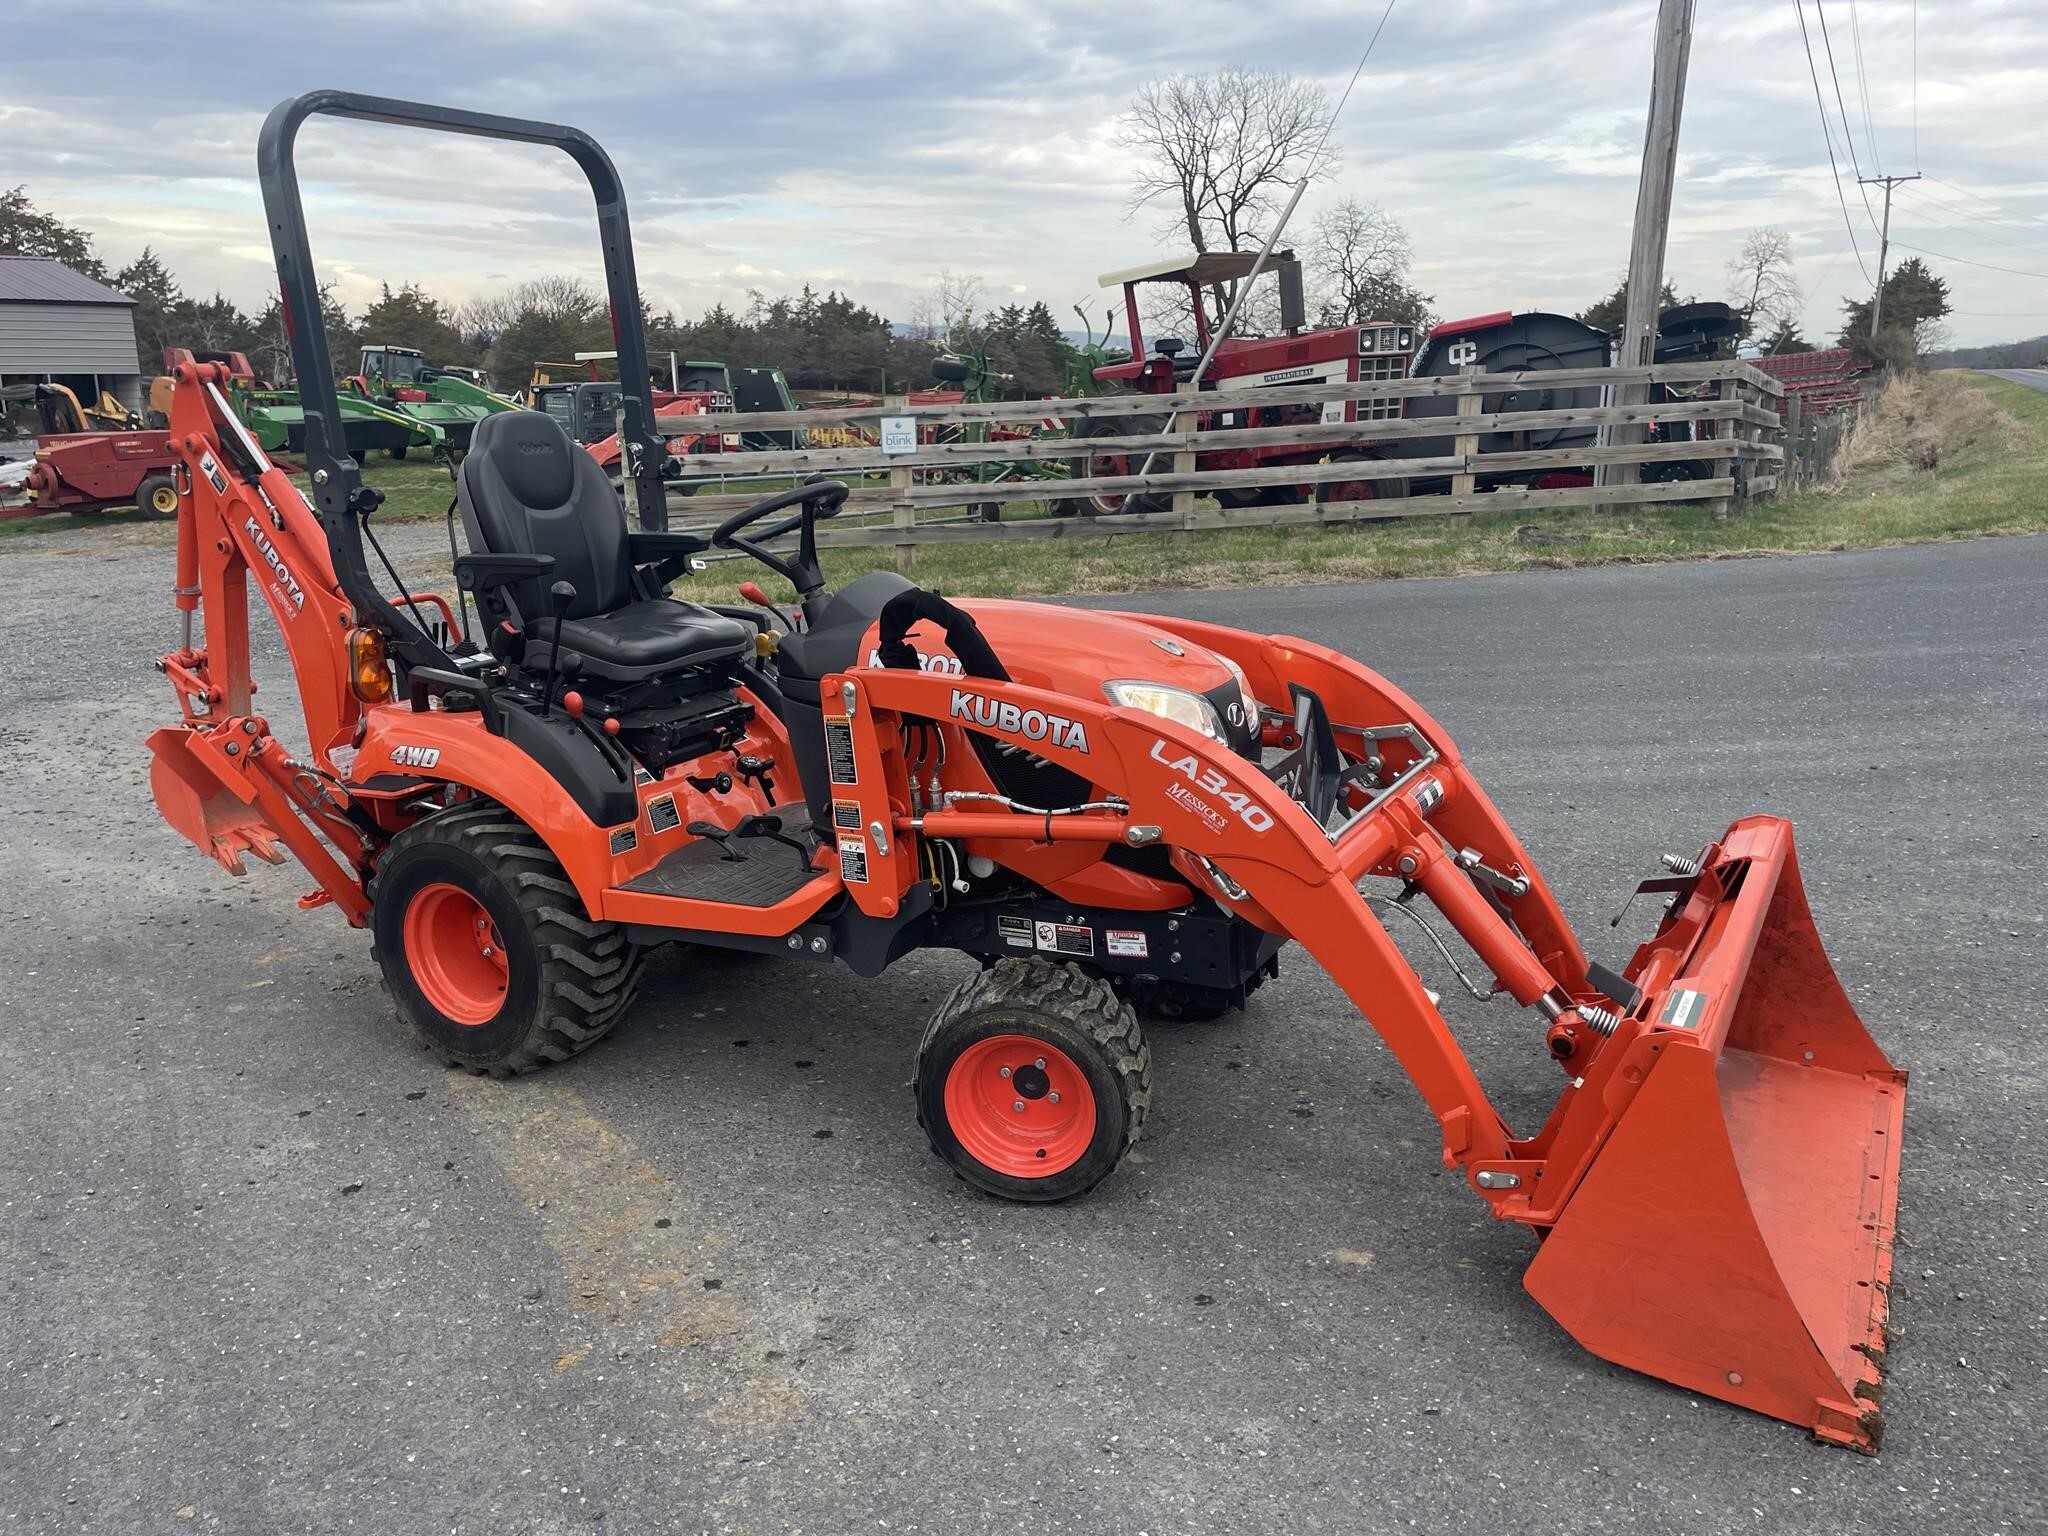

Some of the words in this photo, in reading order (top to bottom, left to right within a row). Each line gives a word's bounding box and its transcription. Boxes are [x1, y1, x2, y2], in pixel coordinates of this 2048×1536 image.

[1264, 368, 1314, 382] INTERNATIONAL
[886, 434, 912, 446] blink
[244, 516, 305, 613] KUBOTA
[950, 689, 1090, 755] KUBOTA
[389, 744, 441, 769] 4WD
[1150, 739, 1275, 833] LA340
[1166, 782, 1229, 828] MESSICK'S
